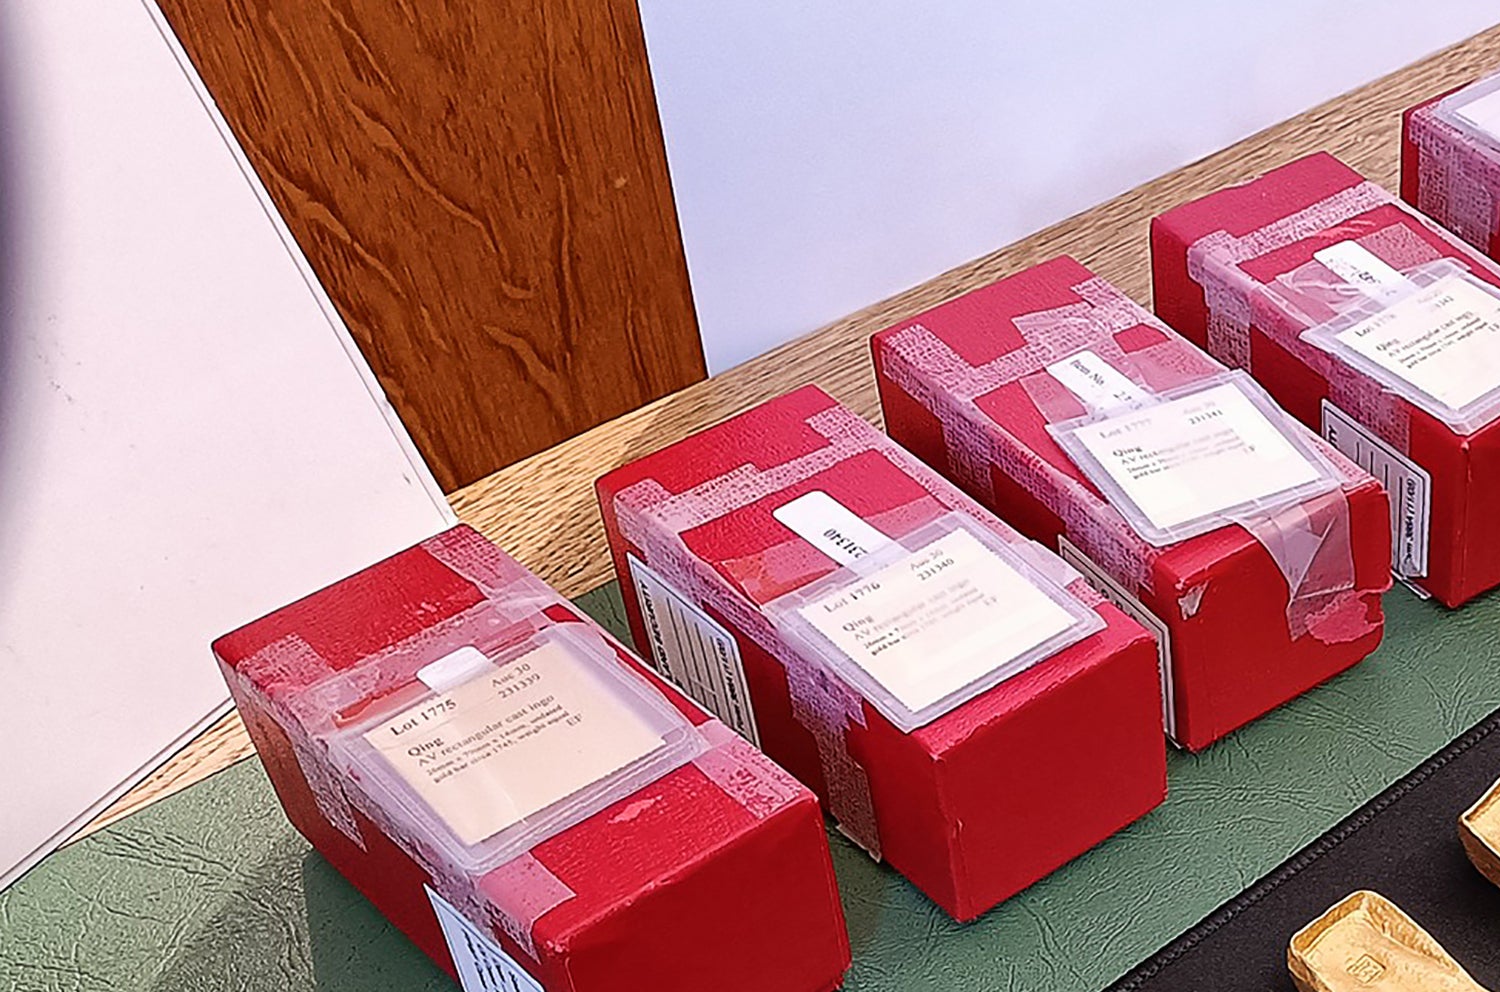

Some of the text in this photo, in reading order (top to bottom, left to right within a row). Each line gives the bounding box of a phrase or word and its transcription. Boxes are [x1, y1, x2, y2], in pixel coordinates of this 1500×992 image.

[498, 673, 540, 699] 231339
[390, 699, 456, 736] Lot 1775
[441, 721, 503, 756] rectangular
[505, 708, 528, 723] cast
[408, 738, 444, 756] Qing
